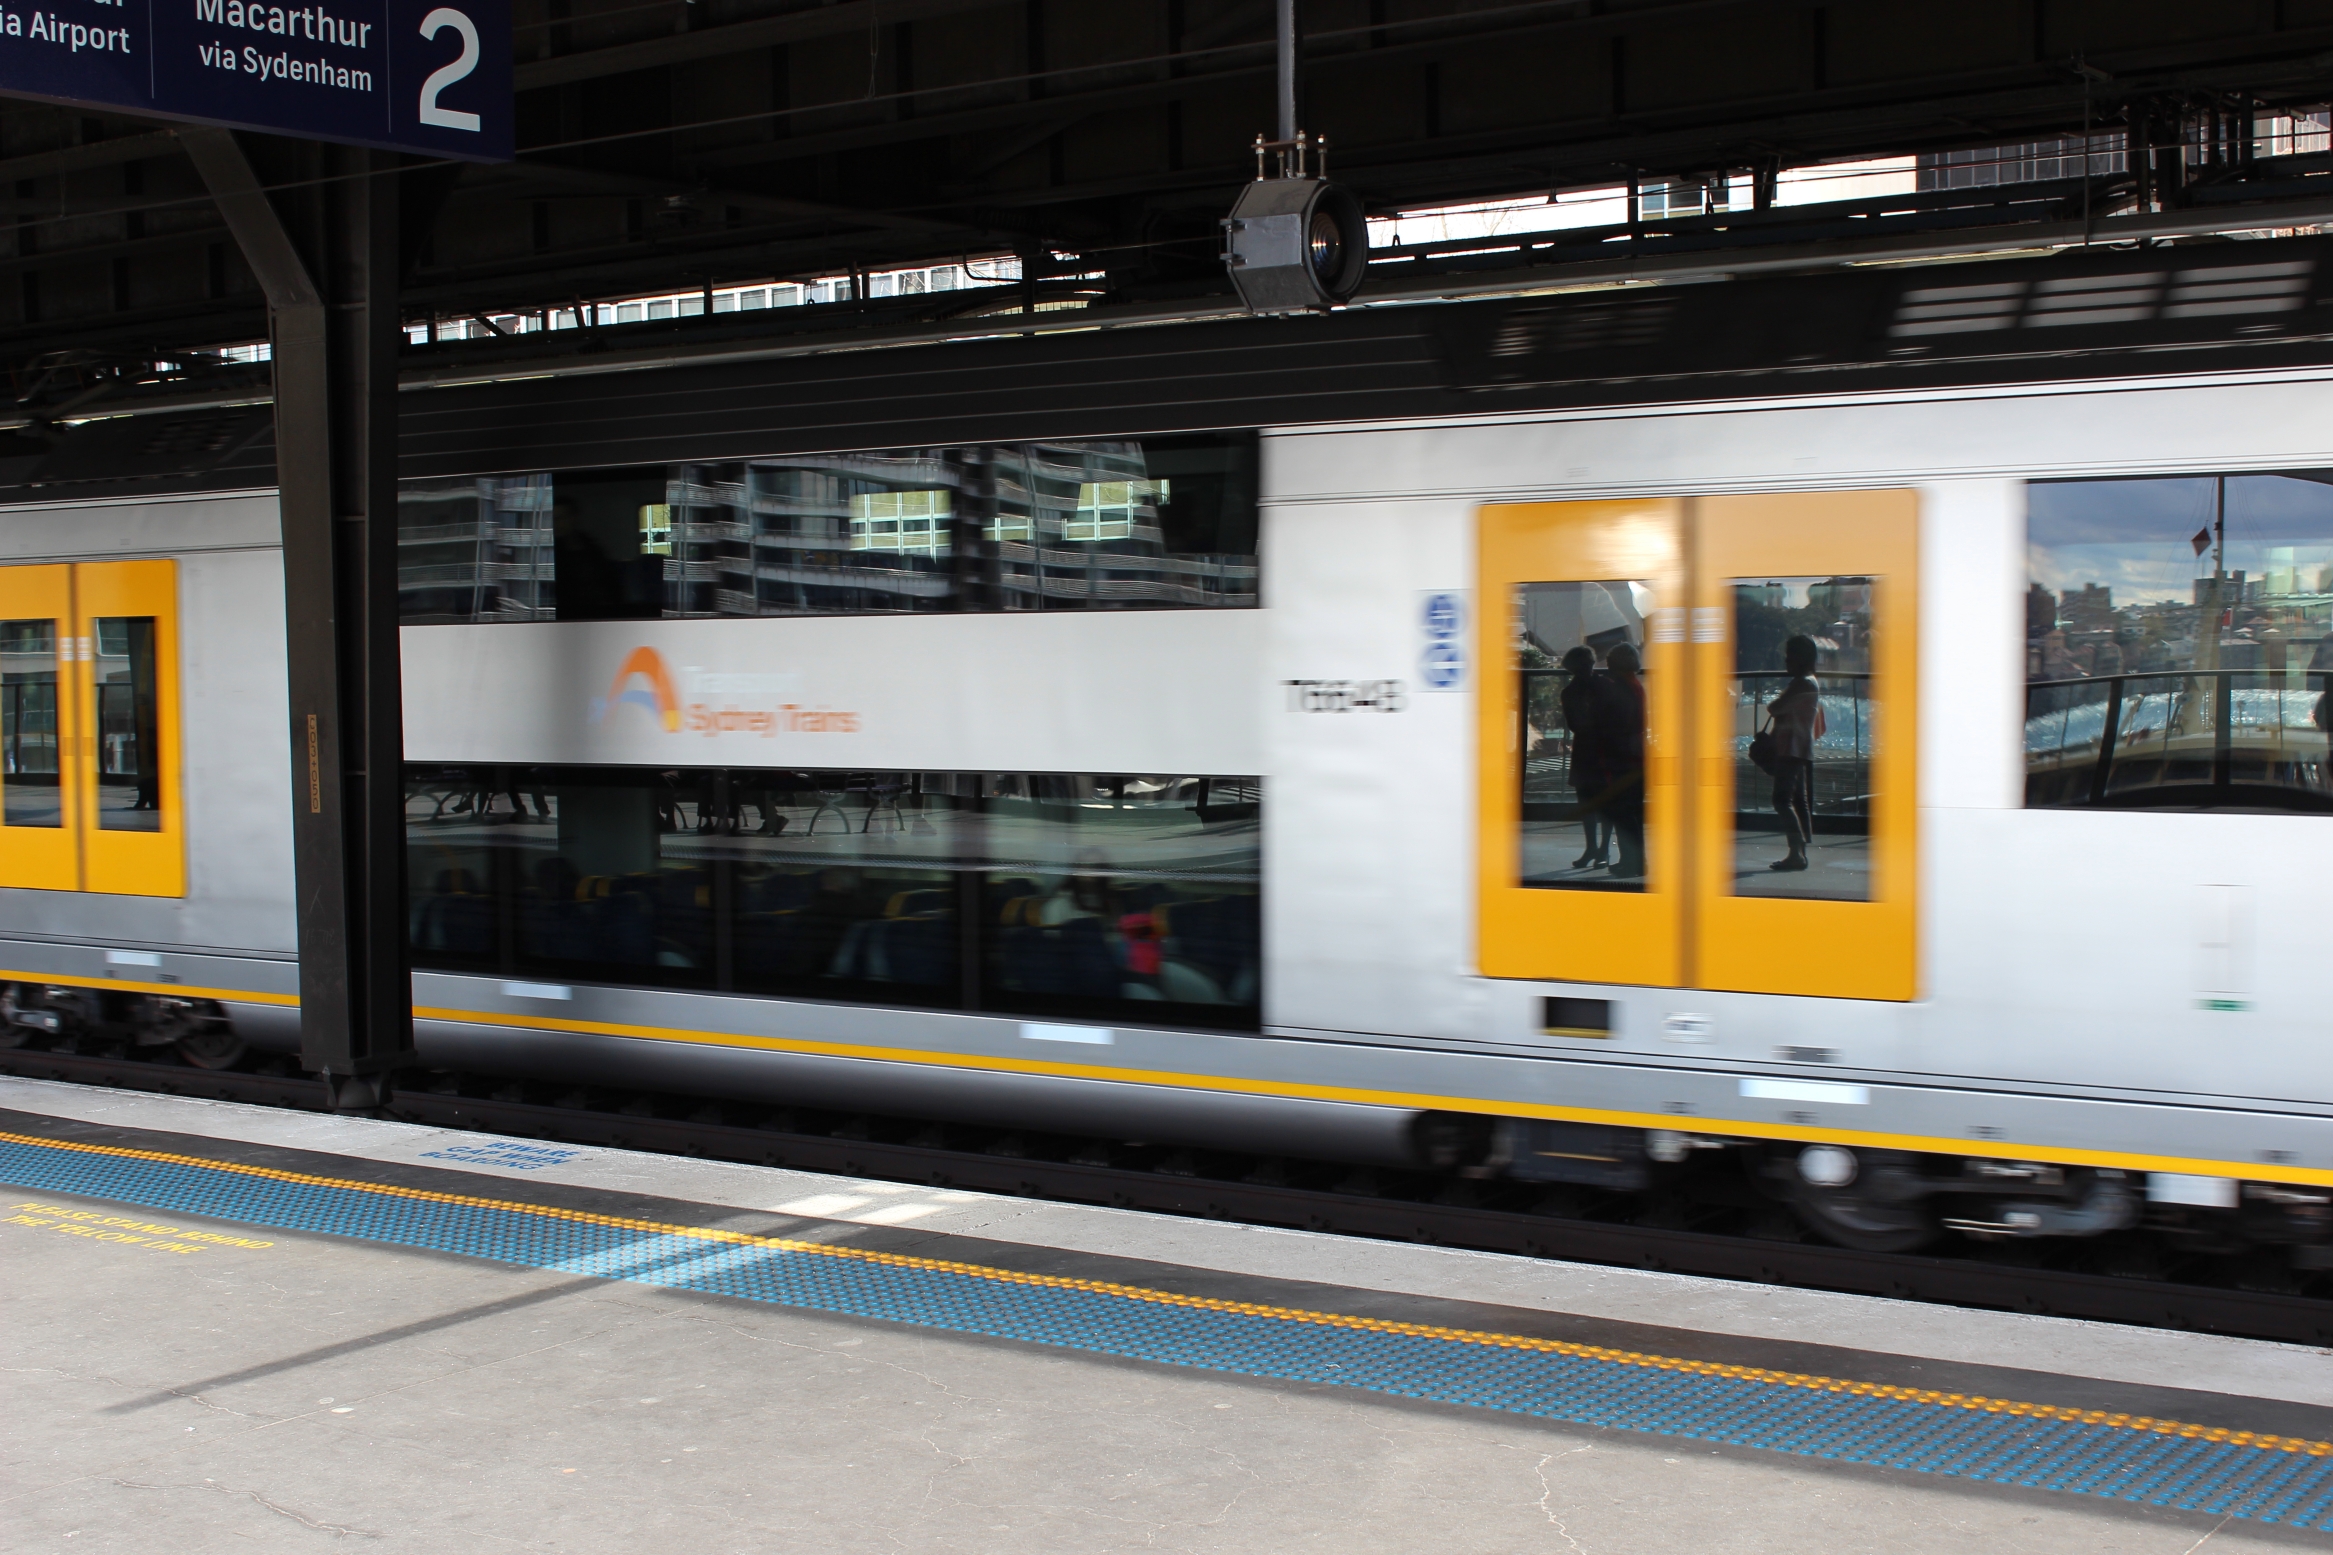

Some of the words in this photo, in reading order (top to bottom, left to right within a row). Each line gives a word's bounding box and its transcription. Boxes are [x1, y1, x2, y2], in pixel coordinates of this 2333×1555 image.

[0, 5, 22, 37] ia
[29, 11, 131, 53] Airport
[196, 0, 372, 49] Macarthur
[199, 43, 237, 71] via
[243, 47, 373, 93] Sydenham
[419, 7, 481, 132] 2
[418, 1151, 544, 1170] BOARDING
[446, 1146, 502, 1158] GAP
[499, 1153, 571, 1165] WHEN
[486, 1142, 581, 1158] BEWARE
[1, 1215, 56, 1228] THE
[48, 1223, 151, 1245] YELLOW
[142, 1240, 209, 1255] LINE
[9, 1202, 103, 1221] PLEASE
[92, 1217, 179, 1236] STAND
[174, 1231, 275, 1250] BEHIND
